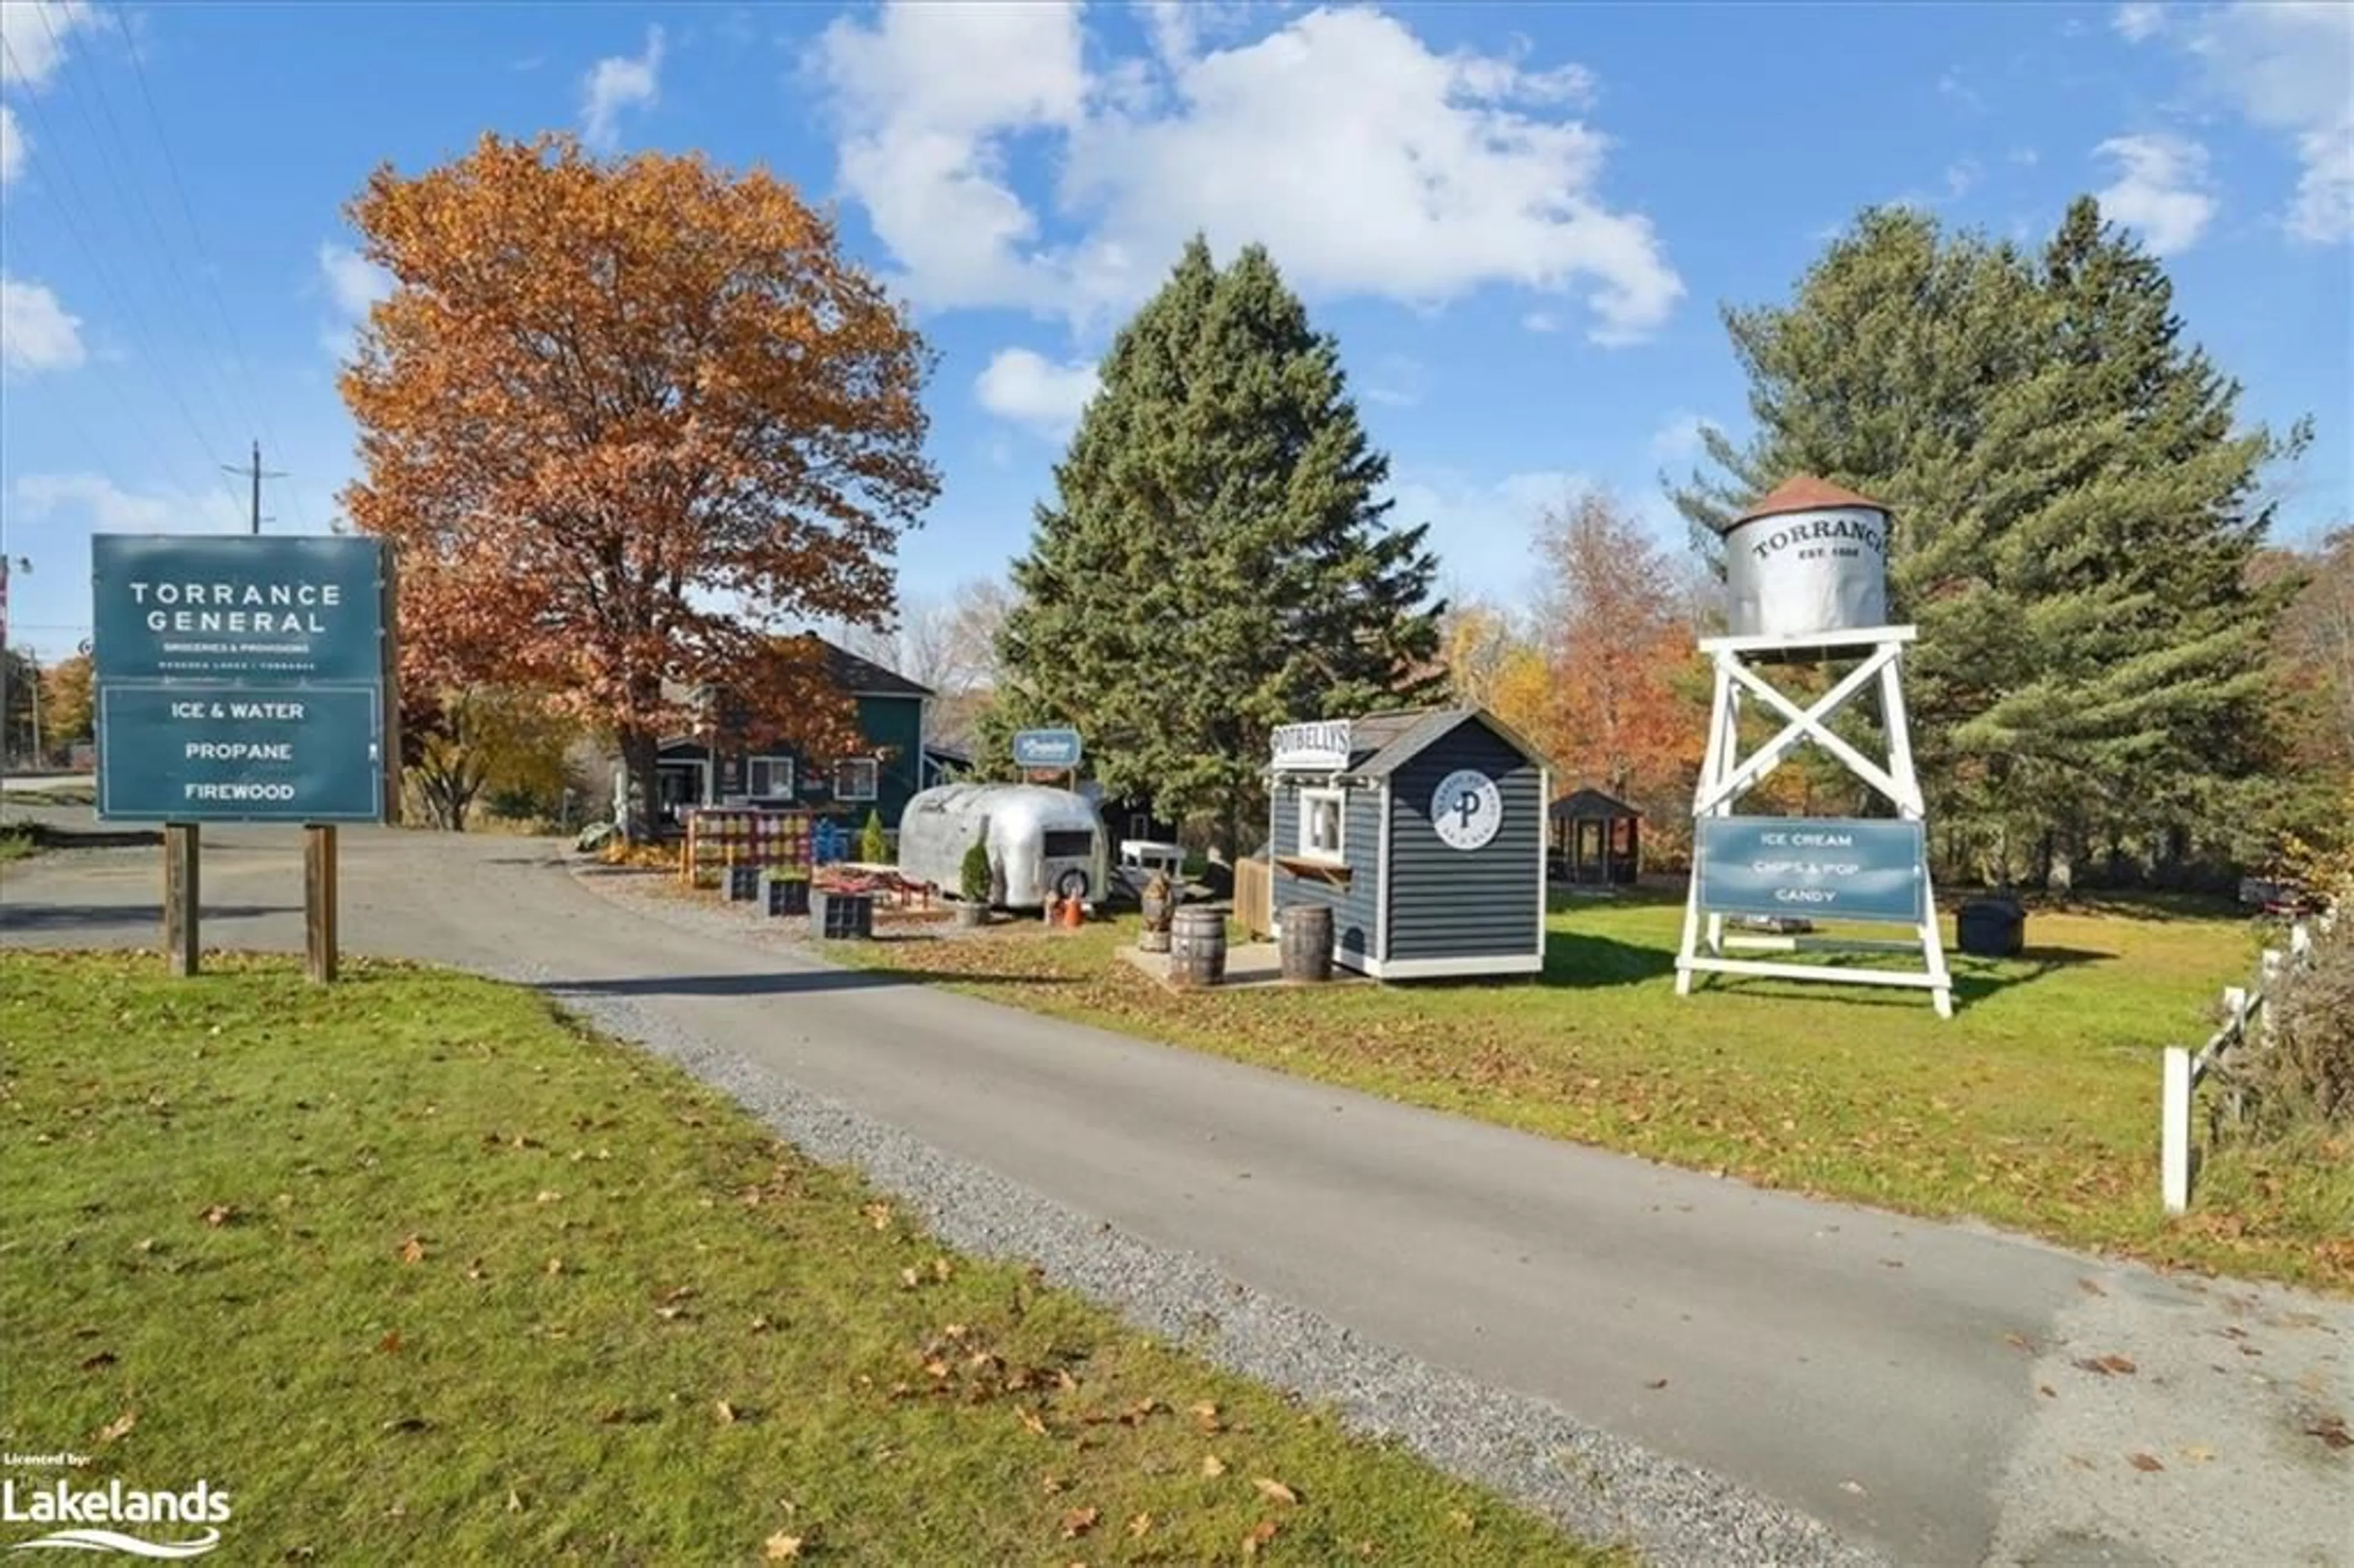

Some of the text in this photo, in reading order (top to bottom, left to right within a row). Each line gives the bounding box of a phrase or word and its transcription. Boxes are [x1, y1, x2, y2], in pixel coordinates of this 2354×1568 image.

[130, 584, 340, 606] TORRANCE
[147, 611, 325, 633] GENERAL
[172, 703, 304, 719] ICE & WATER
[186, 744, 293, 760] PROPANE
[185, 784, 295, 799] FIREWOOD
[1761, 833, 1853, 847] ICE CREAM
[1753, 861, 1859, 875] CHIPS & POP
[1775, 889, 1837, 902] CANDY
